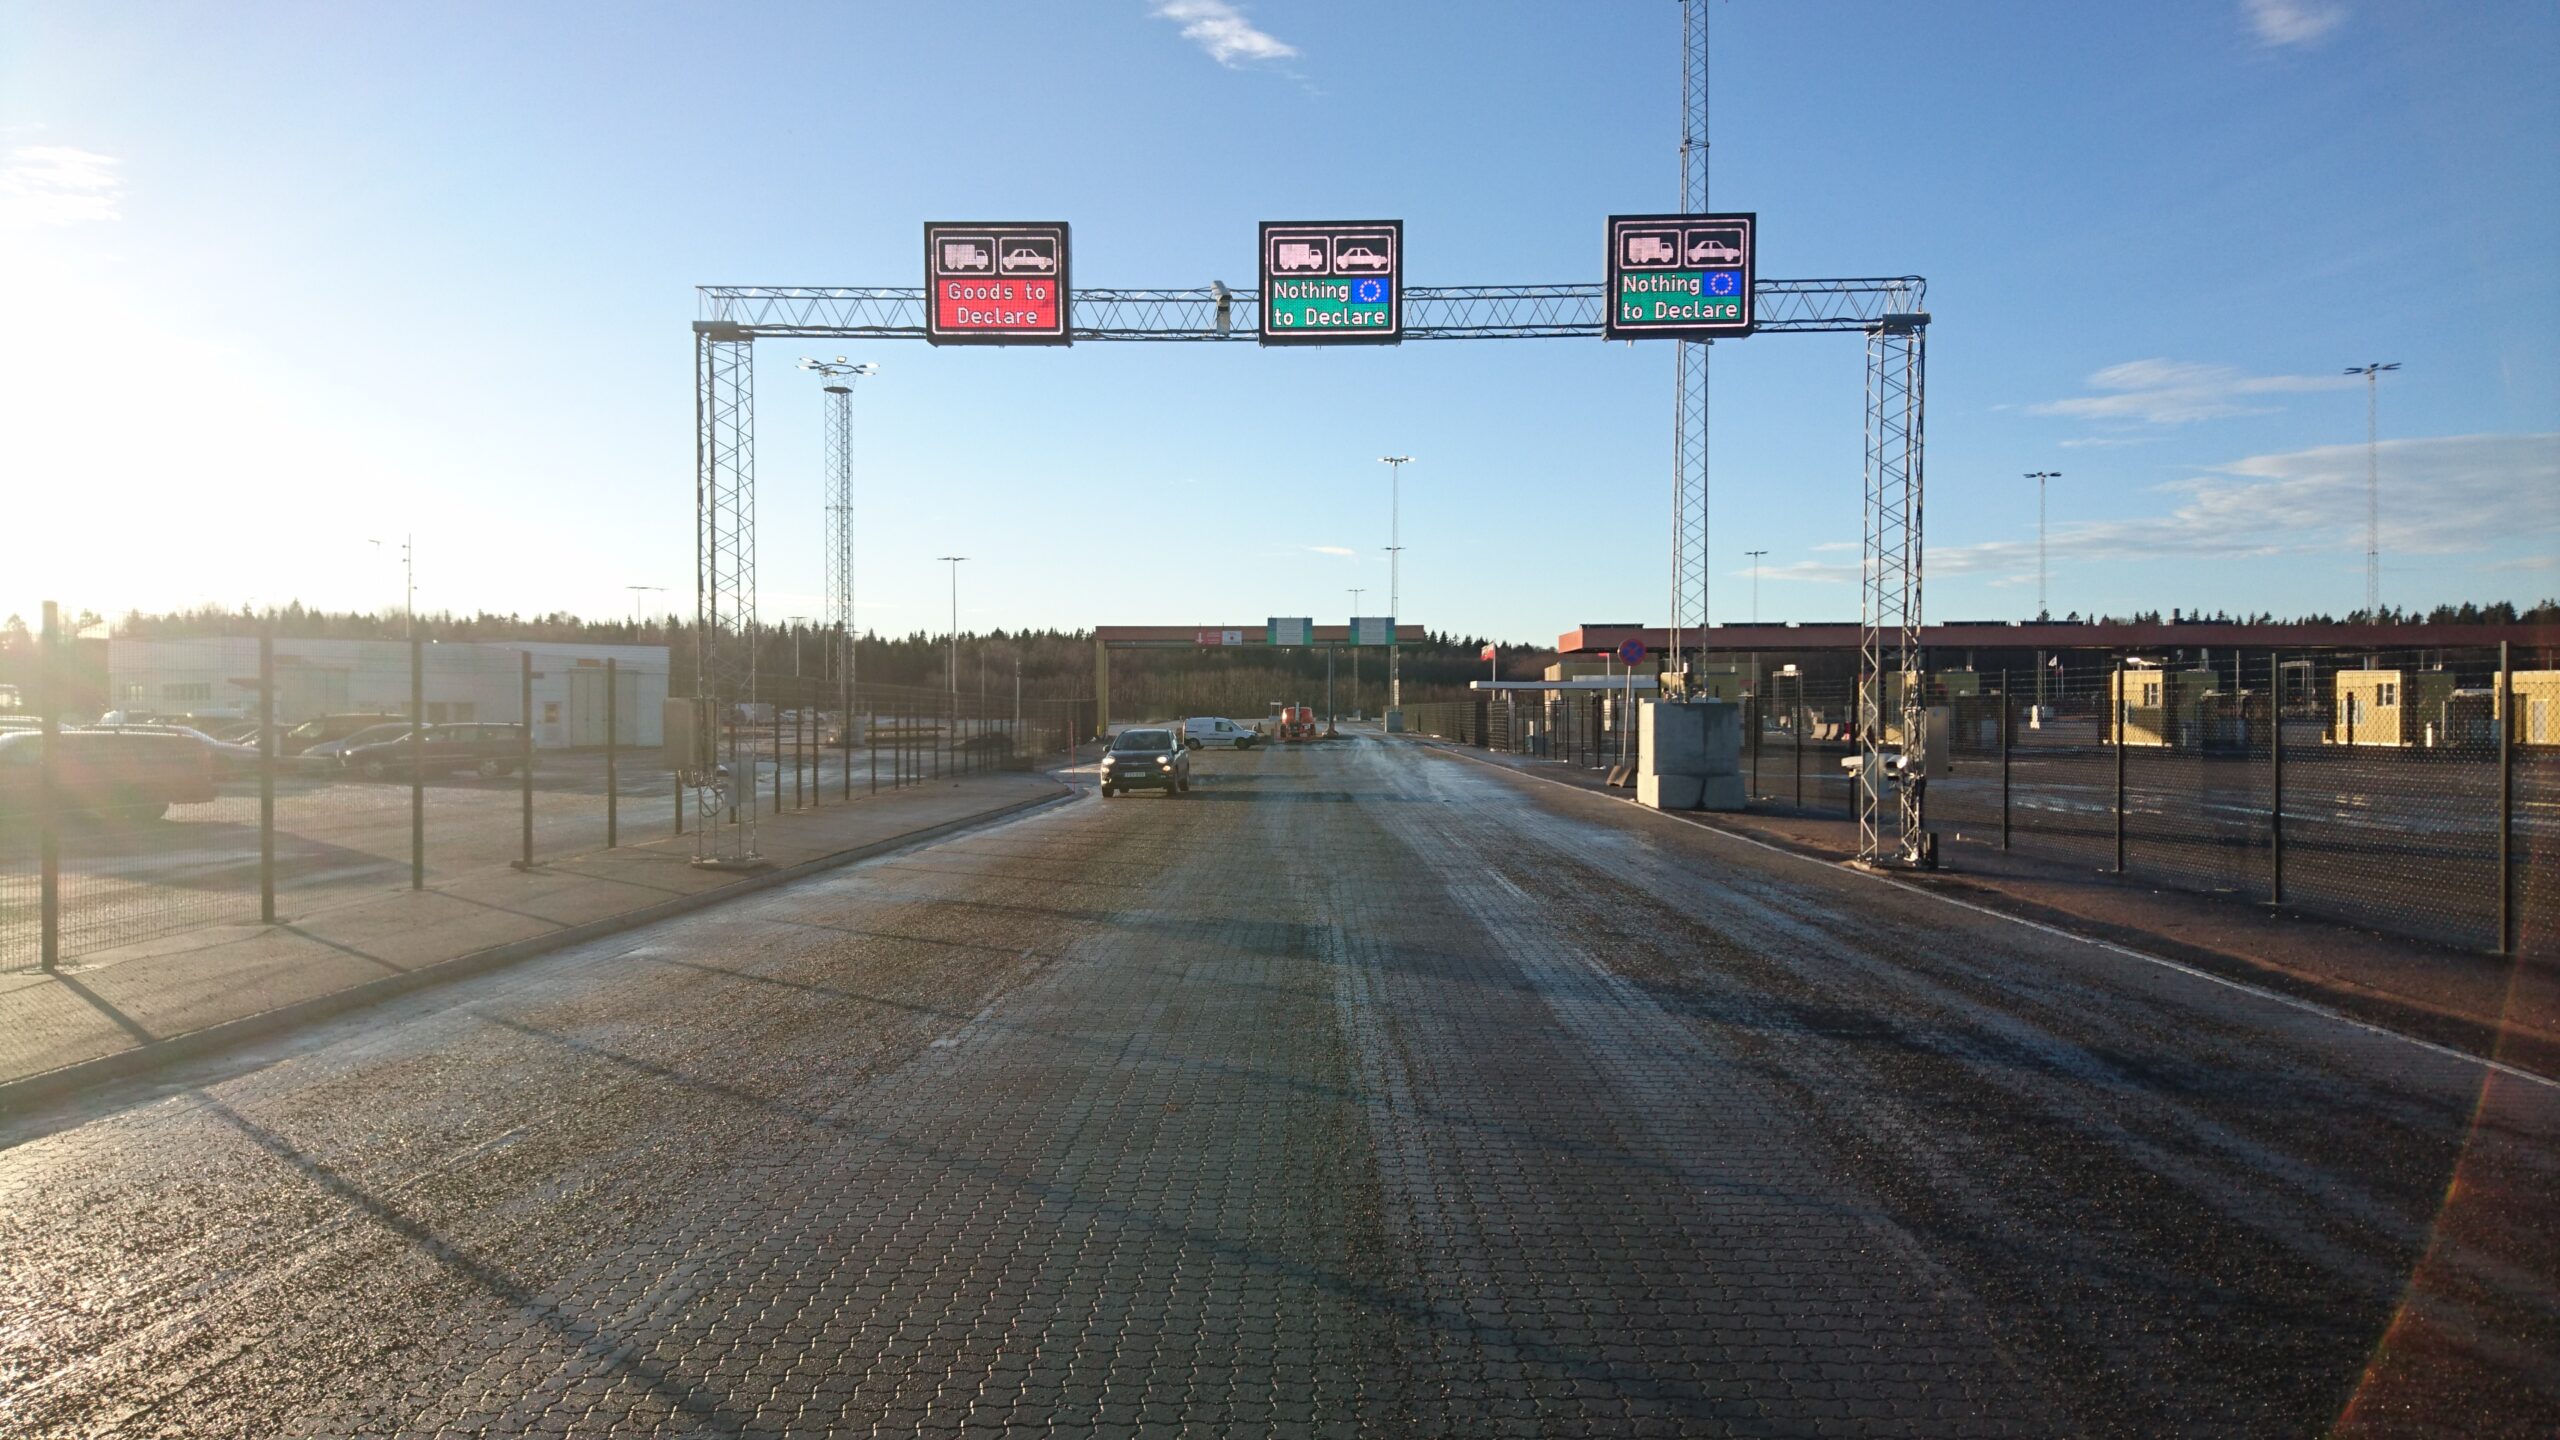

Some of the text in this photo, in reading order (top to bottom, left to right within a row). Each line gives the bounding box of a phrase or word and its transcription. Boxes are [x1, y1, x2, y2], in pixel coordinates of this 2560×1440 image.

[947, 282, 1046, 300] Goods to
[1274, 281, 1349, 302] Nothing
[1623, 274, 1701, 296] Nothing
[957, 306, 1038, 325] Declare
[1274, 307, 1386, 325] to Declare
[1623, 300, 1738, 320] to Declare
